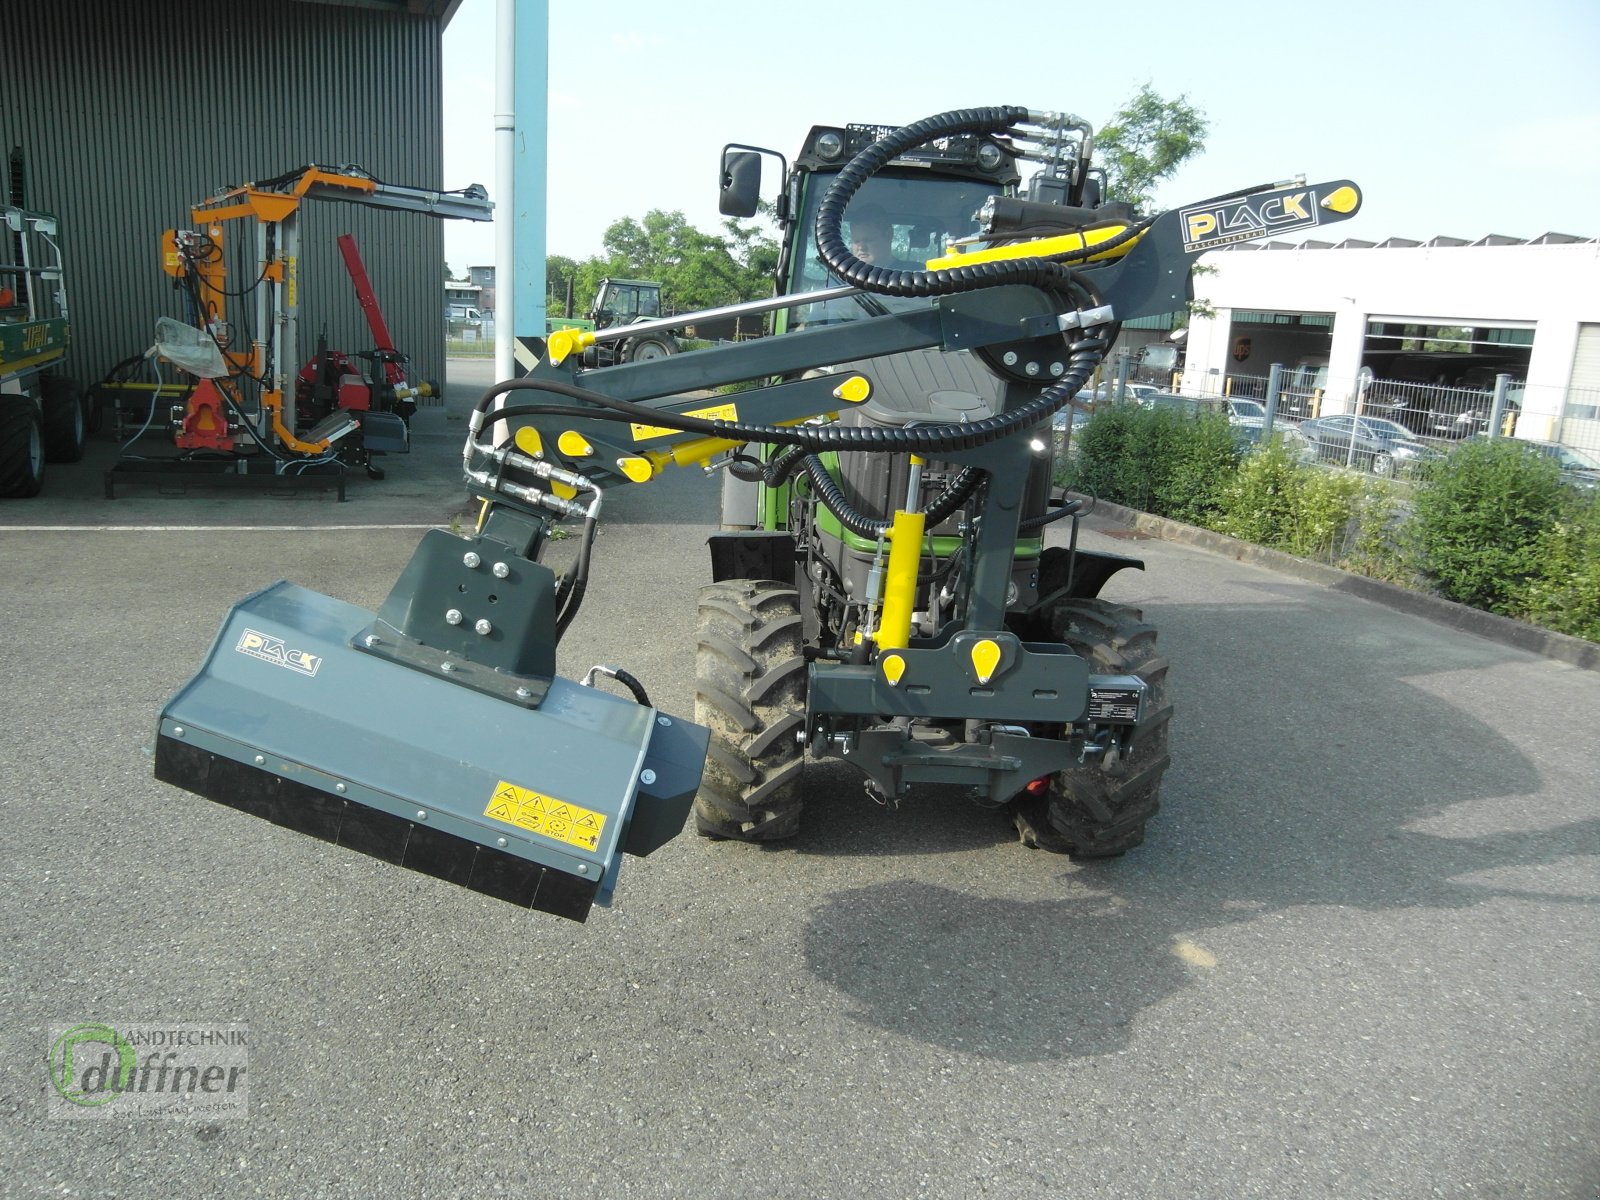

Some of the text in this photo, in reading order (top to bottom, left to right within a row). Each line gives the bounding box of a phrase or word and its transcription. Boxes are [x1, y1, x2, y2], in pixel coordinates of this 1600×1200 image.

[1187, 192, 1310, 241] PLACK
[1186, 231, 1265, 251] MASCHINENBAU
[241, 633, 318, 671] PLACK
[545, 829, 565, 839] STOP
